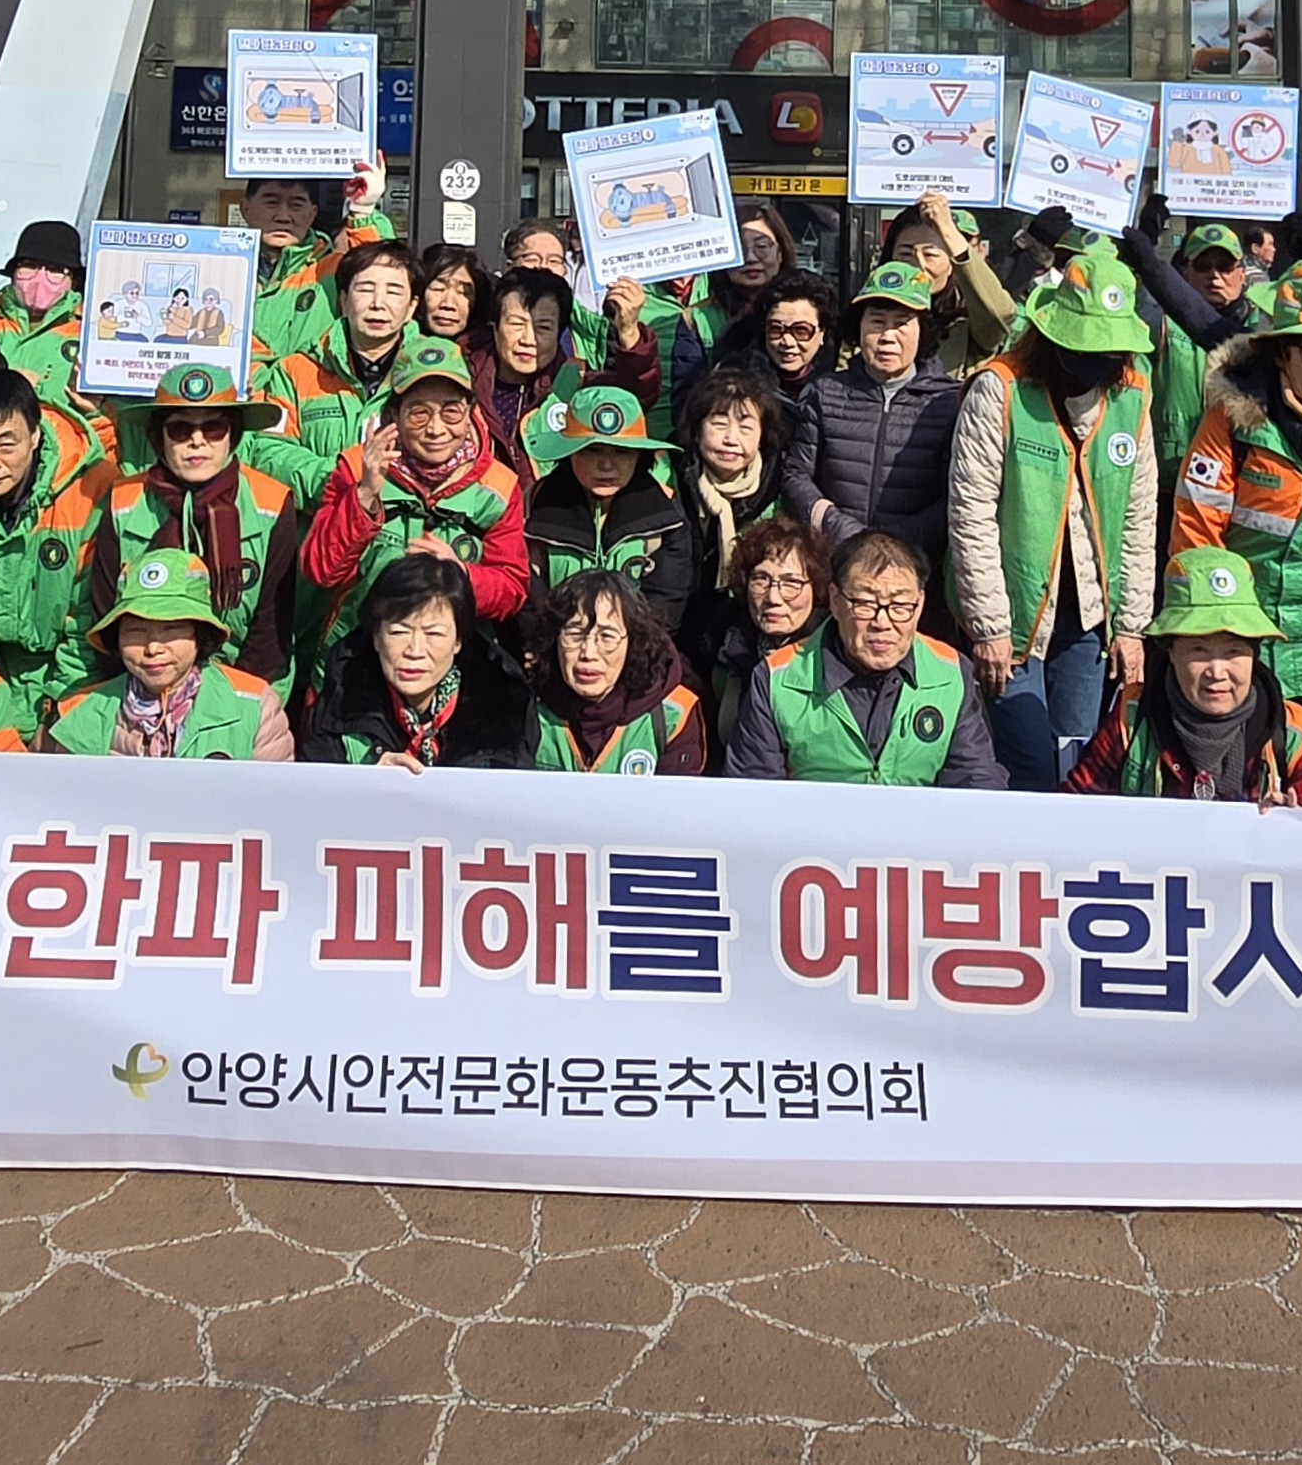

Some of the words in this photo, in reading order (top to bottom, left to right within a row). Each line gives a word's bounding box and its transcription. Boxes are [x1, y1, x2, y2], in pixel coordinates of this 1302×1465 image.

[181, 105, 227, 123] 신한은
[445, 176, 476, 189] 232
[2, 829, 281, 986] 한파
[318, 845, 733, 993] 피해를
[181, 1050, 930, 1122] 안양시안전문화운동추진협의회
